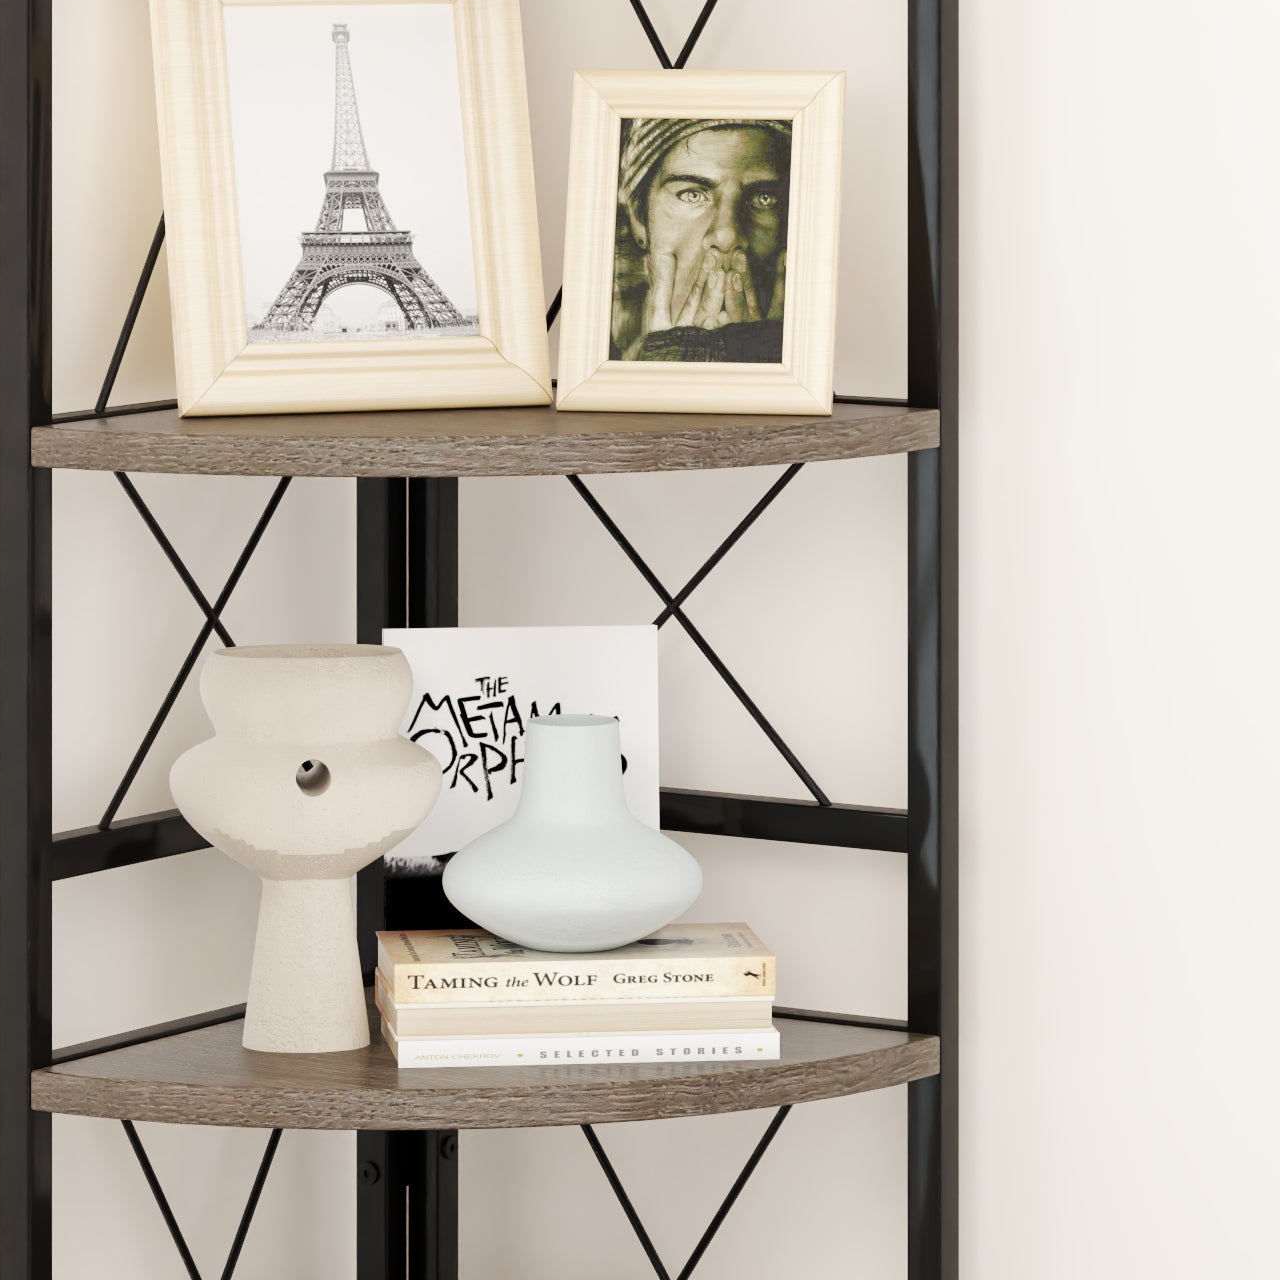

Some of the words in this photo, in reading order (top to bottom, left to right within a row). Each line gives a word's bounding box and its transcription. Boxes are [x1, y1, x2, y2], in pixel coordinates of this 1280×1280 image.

[475, 676, 509, 698] THE
[407, 975, 498, 990] TAMING
[506, 976, 529, 988] the
[533, 972, 598, 987] WOLF
[613, 973, 658, 985] GREG
[663, 971, 714, 984] STONE
[540, 1049, 639, 1058] SELECTED
[656, 1046, 742, 1056] STORIES
